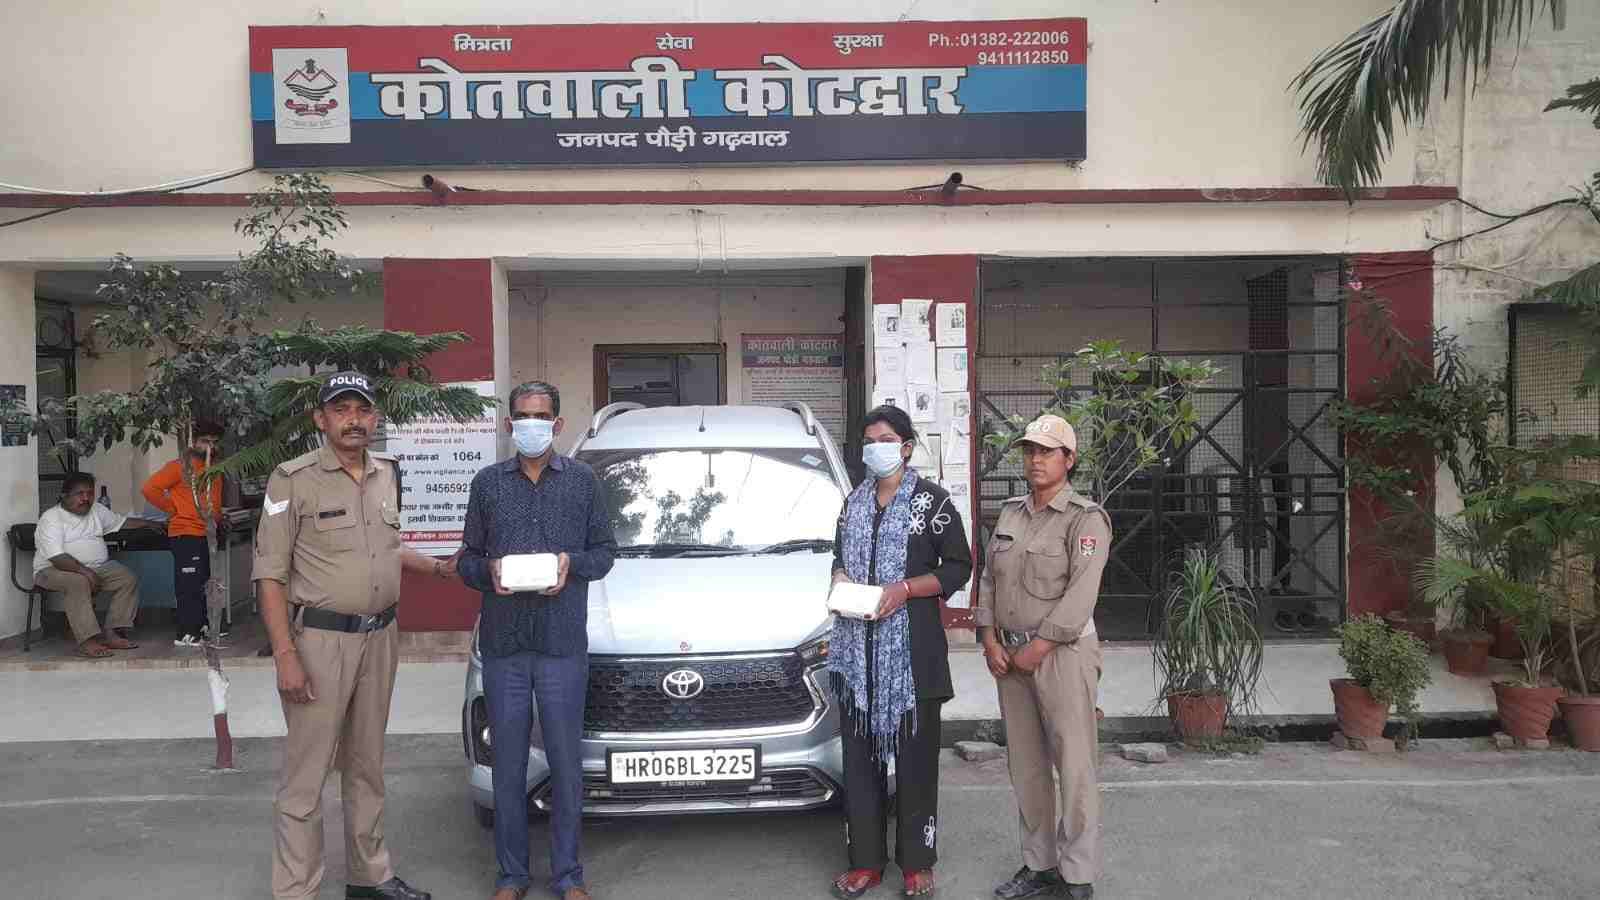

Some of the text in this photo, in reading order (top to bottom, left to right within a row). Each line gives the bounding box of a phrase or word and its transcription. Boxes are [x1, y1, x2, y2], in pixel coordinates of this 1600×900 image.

[453, 34, 513, 52] मित्रता
[656, 33, 694, 51] सेवा
[832, 33, 885, 55] सुरक्षा
[977, 50, 1070, 65] 9411112850
[370, 54, 968, 121] कोतवाली कोटद्वार
[556, 126, 791, 152] जनपद पौड़ी गढ़वाल
[329, 375, 370, 390] POLICE
[453, 451, 482, 461] 1064
[625, 754, 753, 778] HR06BL3225
